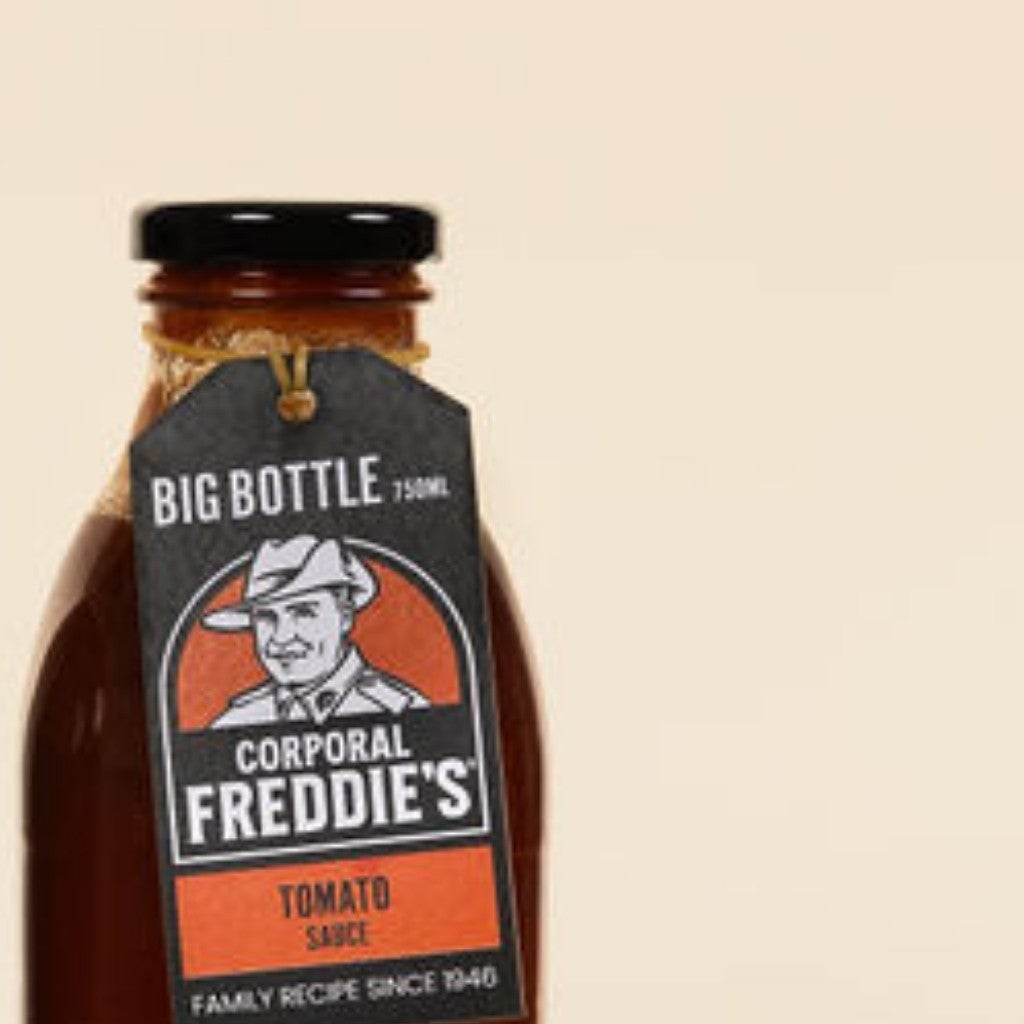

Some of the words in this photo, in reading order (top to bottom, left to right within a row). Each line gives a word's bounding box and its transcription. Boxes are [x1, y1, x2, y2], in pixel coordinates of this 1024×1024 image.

[151, 474, 222, 528] BIG
[230, 454, 382, 519] BOTTLE
[392, 476, 450, 502] 750ML
[235, 723, 411, 775] CORPORAL
[185, 757, 473, 845] FREDDIE'S
[278, 876, 390, 918] TOMATO
[305, 921, 369, 951] SAUCE
[191, 987, 274, 1016] FAMILY
[278, 977, 362, 1009] RECIPE
[367, 970, 440, 999] SINCE
